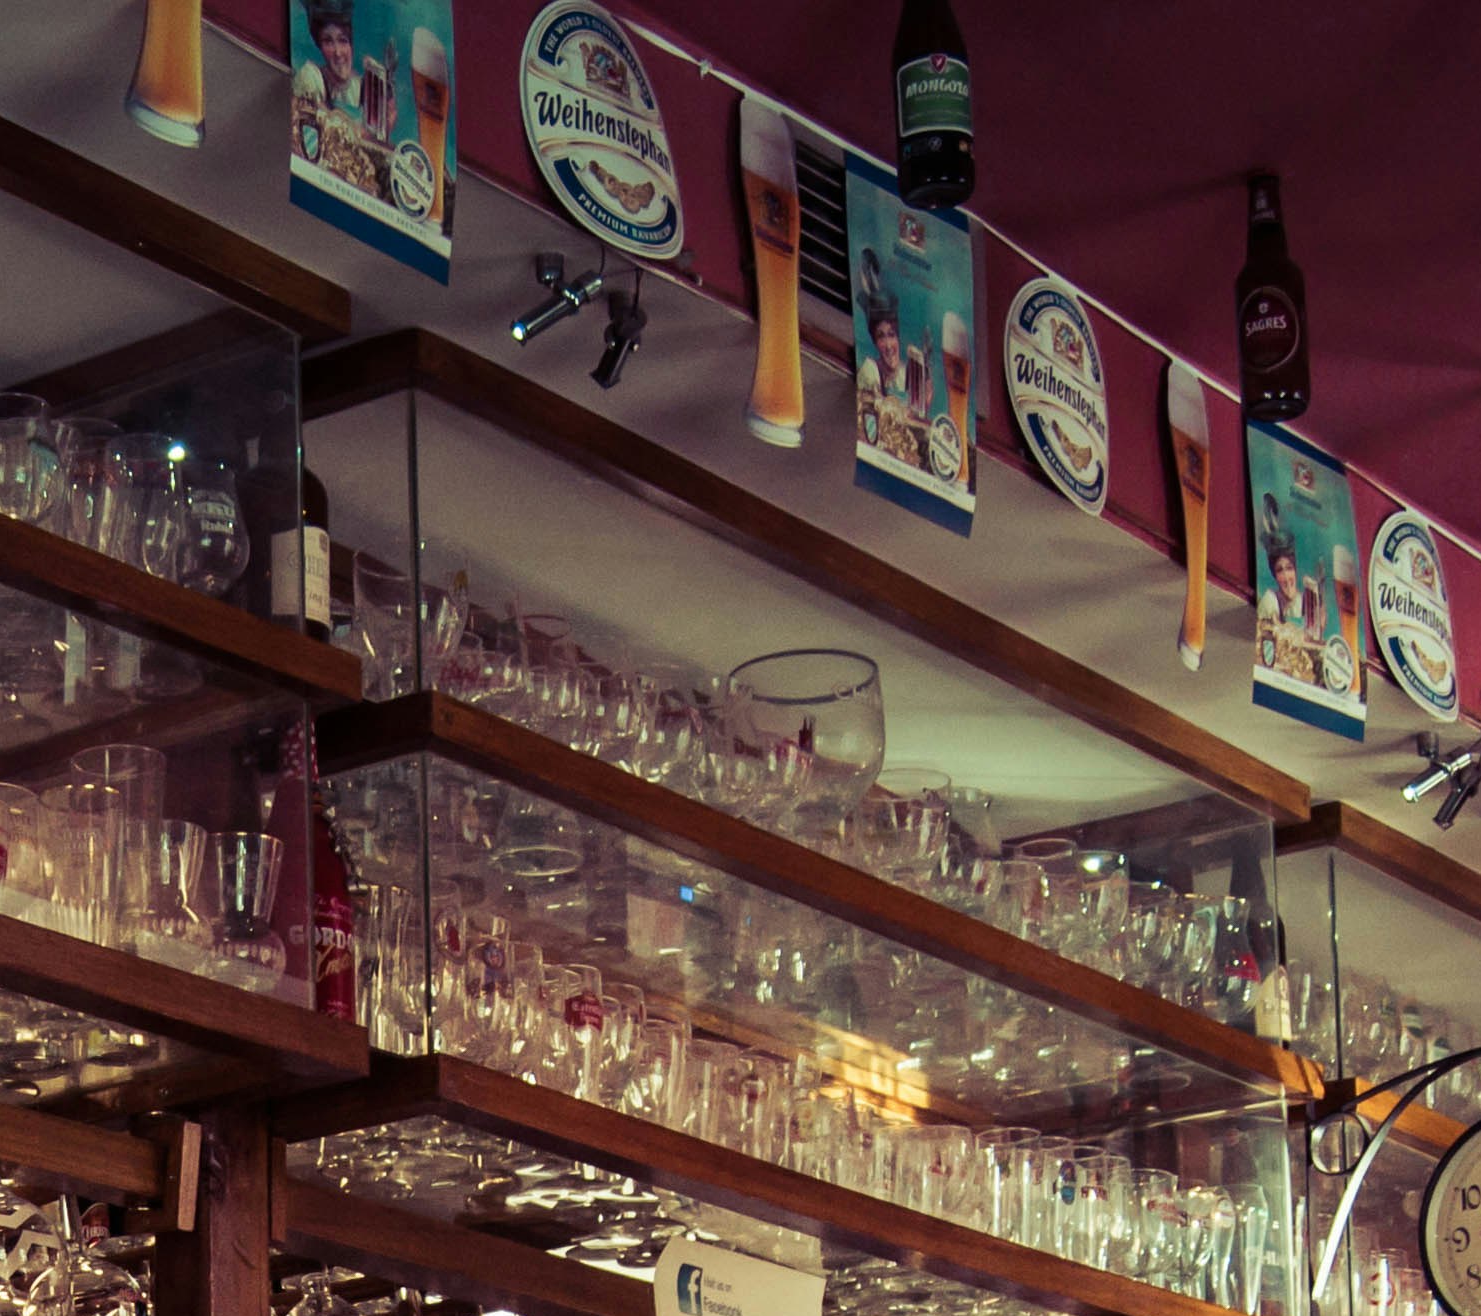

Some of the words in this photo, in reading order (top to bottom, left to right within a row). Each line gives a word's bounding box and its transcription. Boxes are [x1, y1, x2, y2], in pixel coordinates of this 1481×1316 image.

[534, 90, 674, 178] Weihenstephan
[577, 192, 630, 237] PREMIUM
[1245, 314, 1287, 337] SAGRES
[1452, 1226, 1471, 1253] 9
